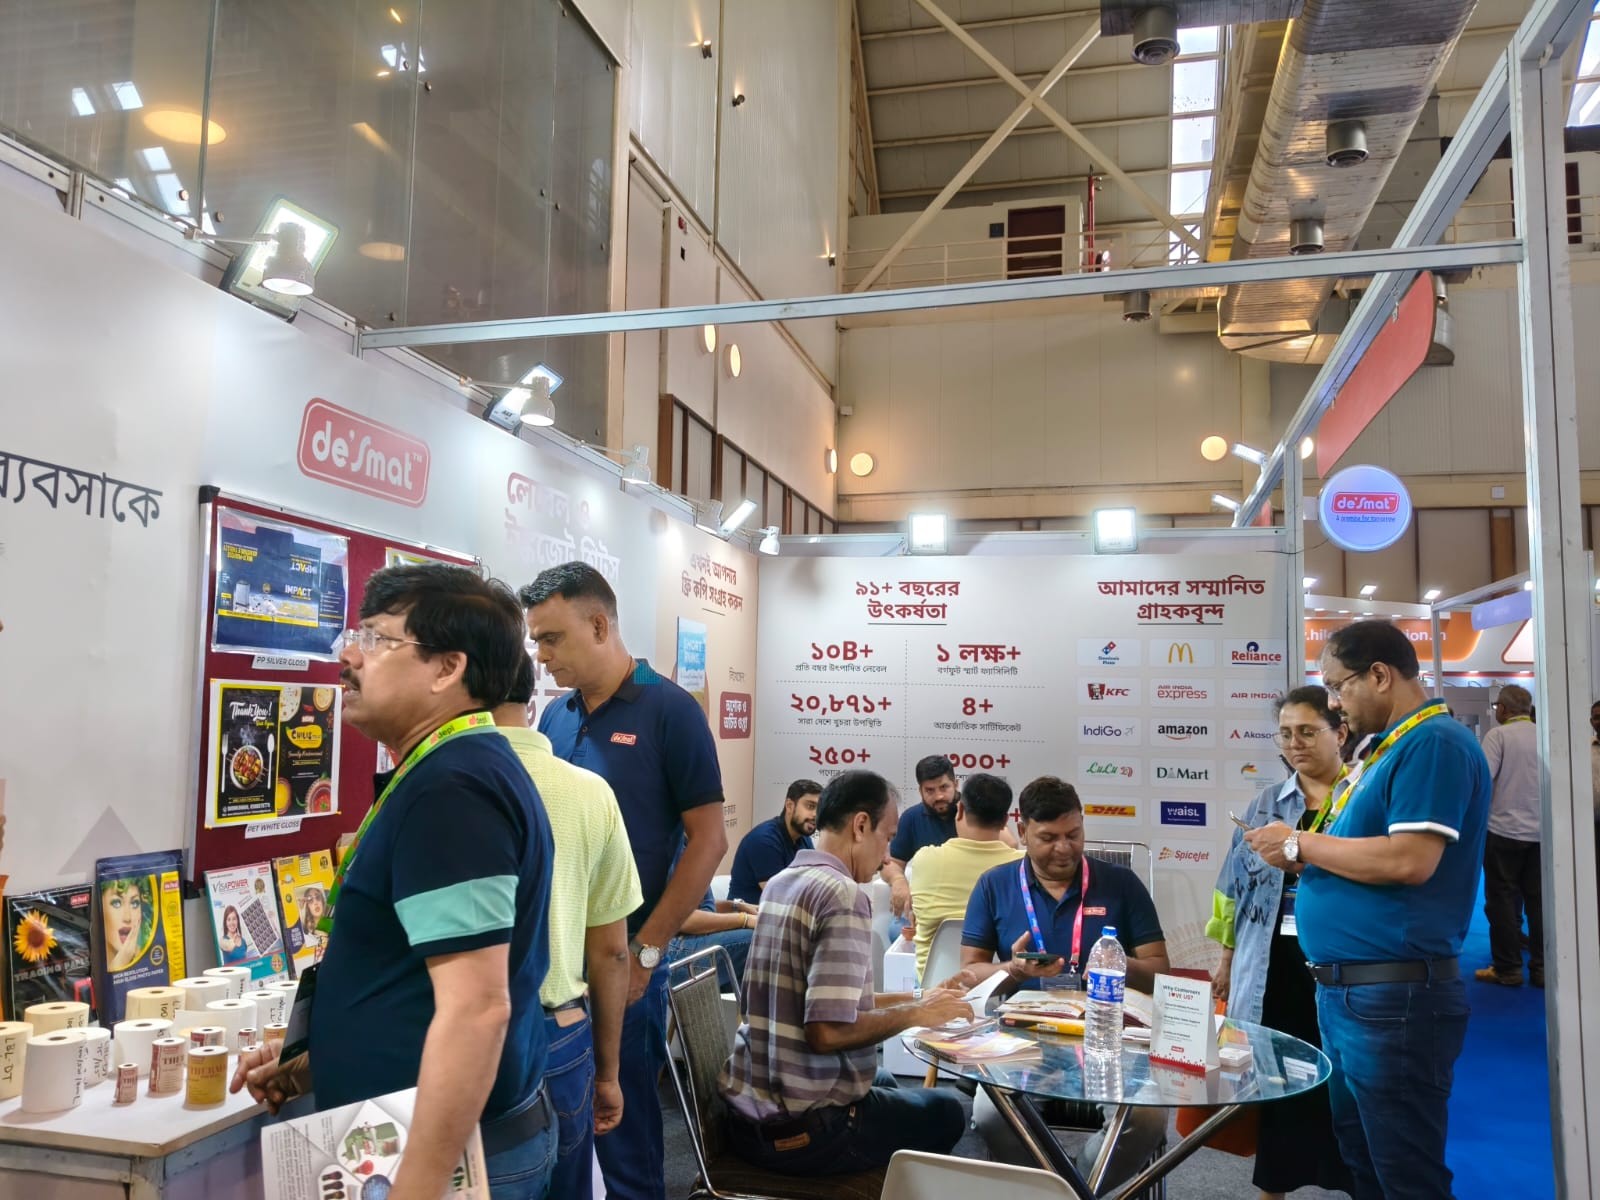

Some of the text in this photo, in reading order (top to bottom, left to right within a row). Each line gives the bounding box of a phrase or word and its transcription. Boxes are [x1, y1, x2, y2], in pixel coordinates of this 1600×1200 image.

[285, 584, 312, 597] IMPACT
[856, 581, 960, 597] ৯১+ বছরের
[1097, 574, 1265, 596] আমাদের সম্মানিত
[867, 599, 947, 618] উৎকর্ষতা
[1137, 603, 1224, 624] গ্রাহকবৃন্দ
[1232, 650, 1281, 661] Reliance
[1106, 688, 1130, 696] KFC
[1158, 690, 1207, 700] express
[791, 693, 891, 715] ২০,৮৭১+
[1084, 725, 1121, 736] IndiGo
[1158, 725, 1207, 735] amazon
[809, 745, 870, 765] ২৫০+
[1092, 806, 1128, 815] DHL
[1175, 850, 1209, 861] SpiceJet
